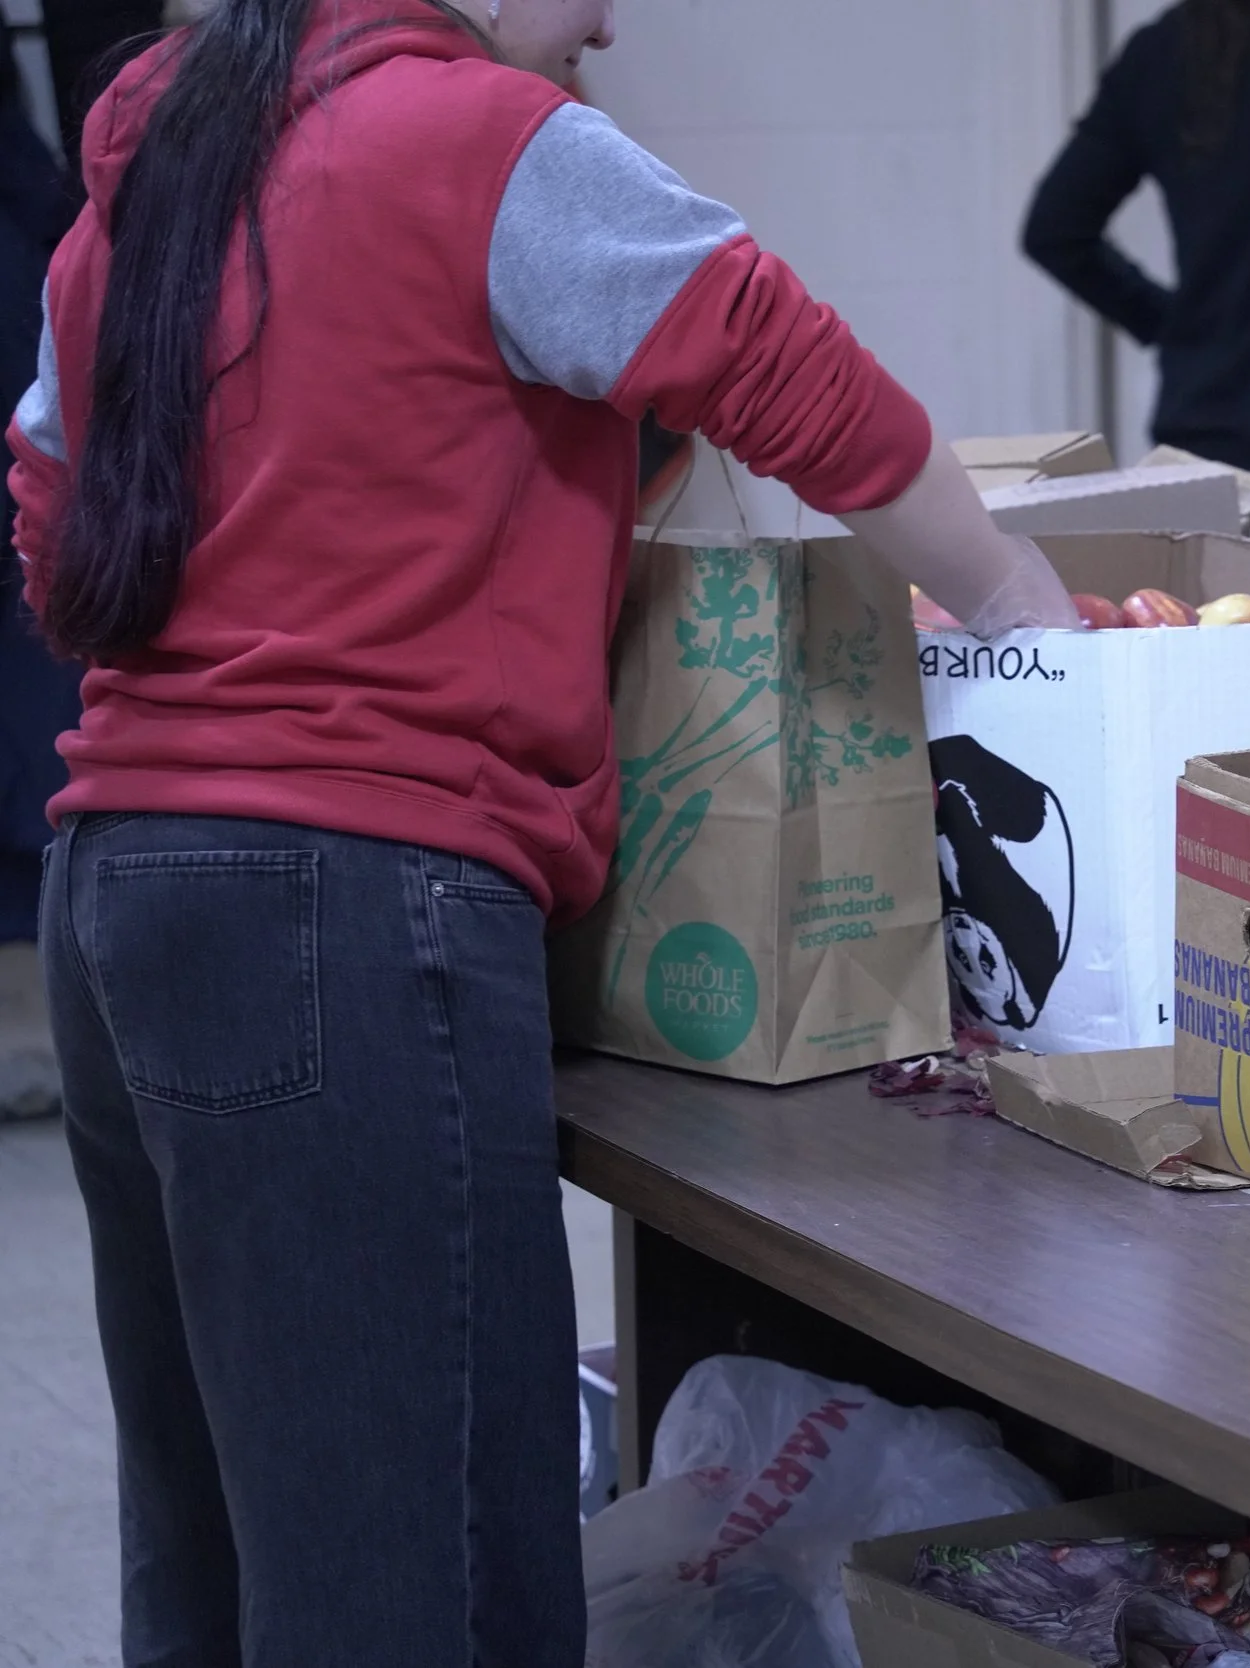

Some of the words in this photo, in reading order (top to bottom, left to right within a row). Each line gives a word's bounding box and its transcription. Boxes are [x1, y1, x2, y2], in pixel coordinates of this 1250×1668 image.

[1178, 834, 1220, 872] BANANAS
[660, 956, 746, 992] WHOLE
[663, 988, 743, 1018] FOODS
